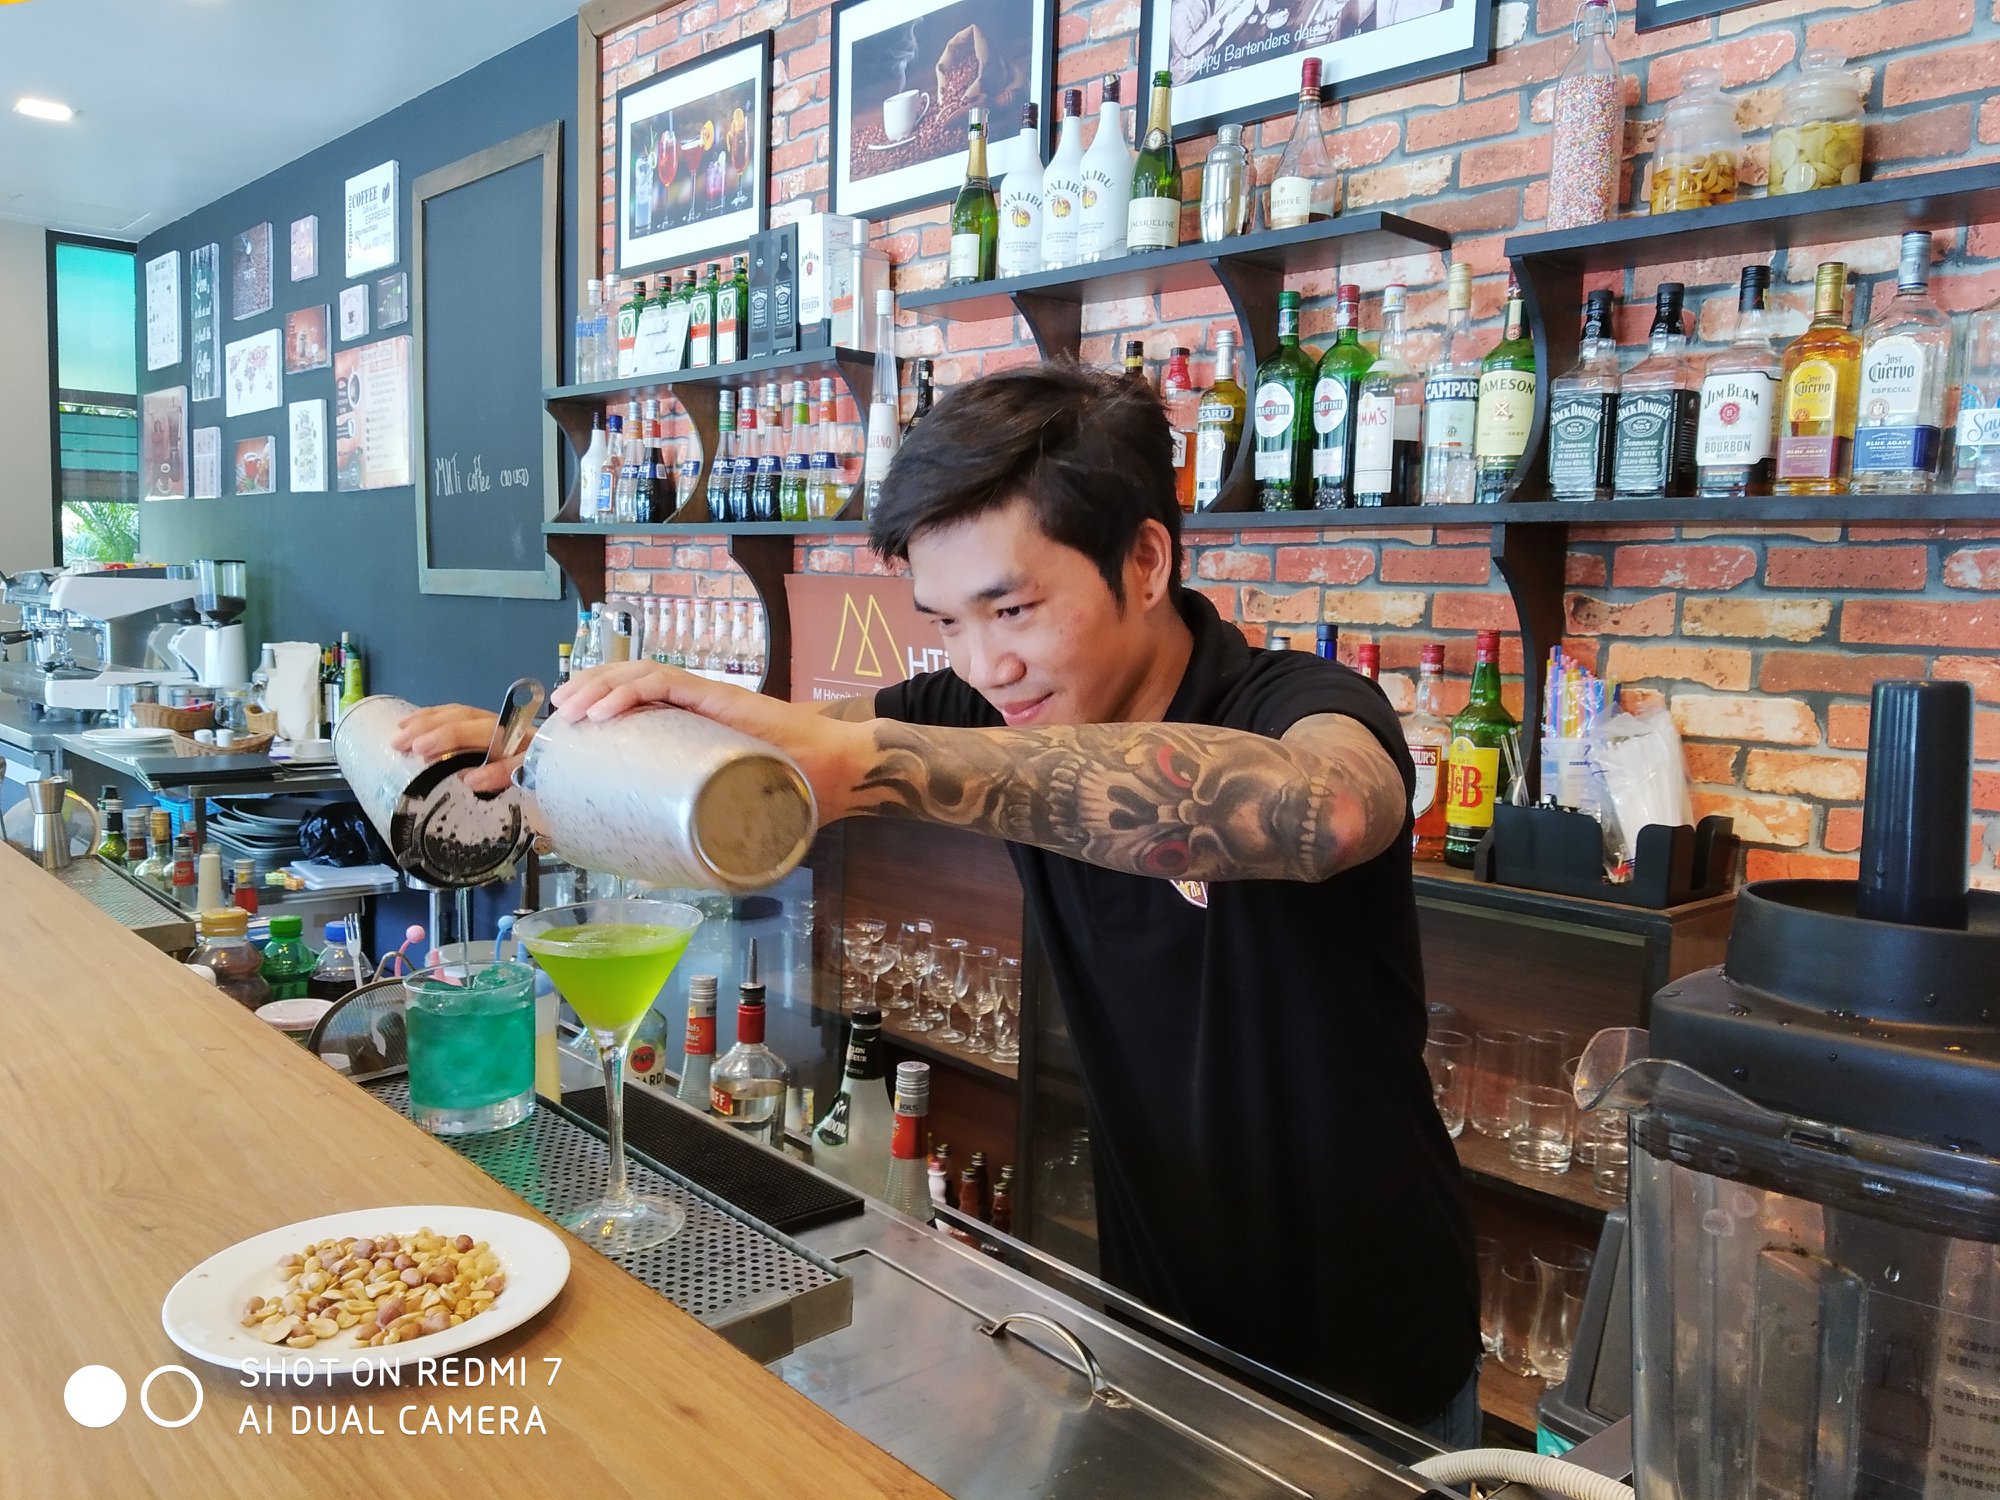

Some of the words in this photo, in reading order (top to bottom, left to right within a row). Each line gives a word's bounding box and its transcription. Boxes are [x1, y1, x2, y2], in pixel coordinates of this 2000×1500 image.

[1183, 53, 1221, 74] Happy
[1224, 32, 1290, 63] Bartenders
[352, 185, 378, 209] COFFEE
[1128, 219, 1175, 232] JACQUELINE
[1869, 362, 1915, 383] Cuervo
[1481, 379, 1535, 396] JAMESON
[1704, 389, 1724, 409] JIM
[1727, 383, 1759, 406] BEAM
[1794, 381, 1830, 396] Cuervo
[1552, 407, 1571, 425] JACK
[1571, 403, 1603, 422] DANIEL'S
[1619, 404, 1637, 421] JACK
[1637, 400, 1671, 419] DANIEL'S
[1705, 441, 1751, 453] BOURBON
[467, 454, 490, 492] coffee
